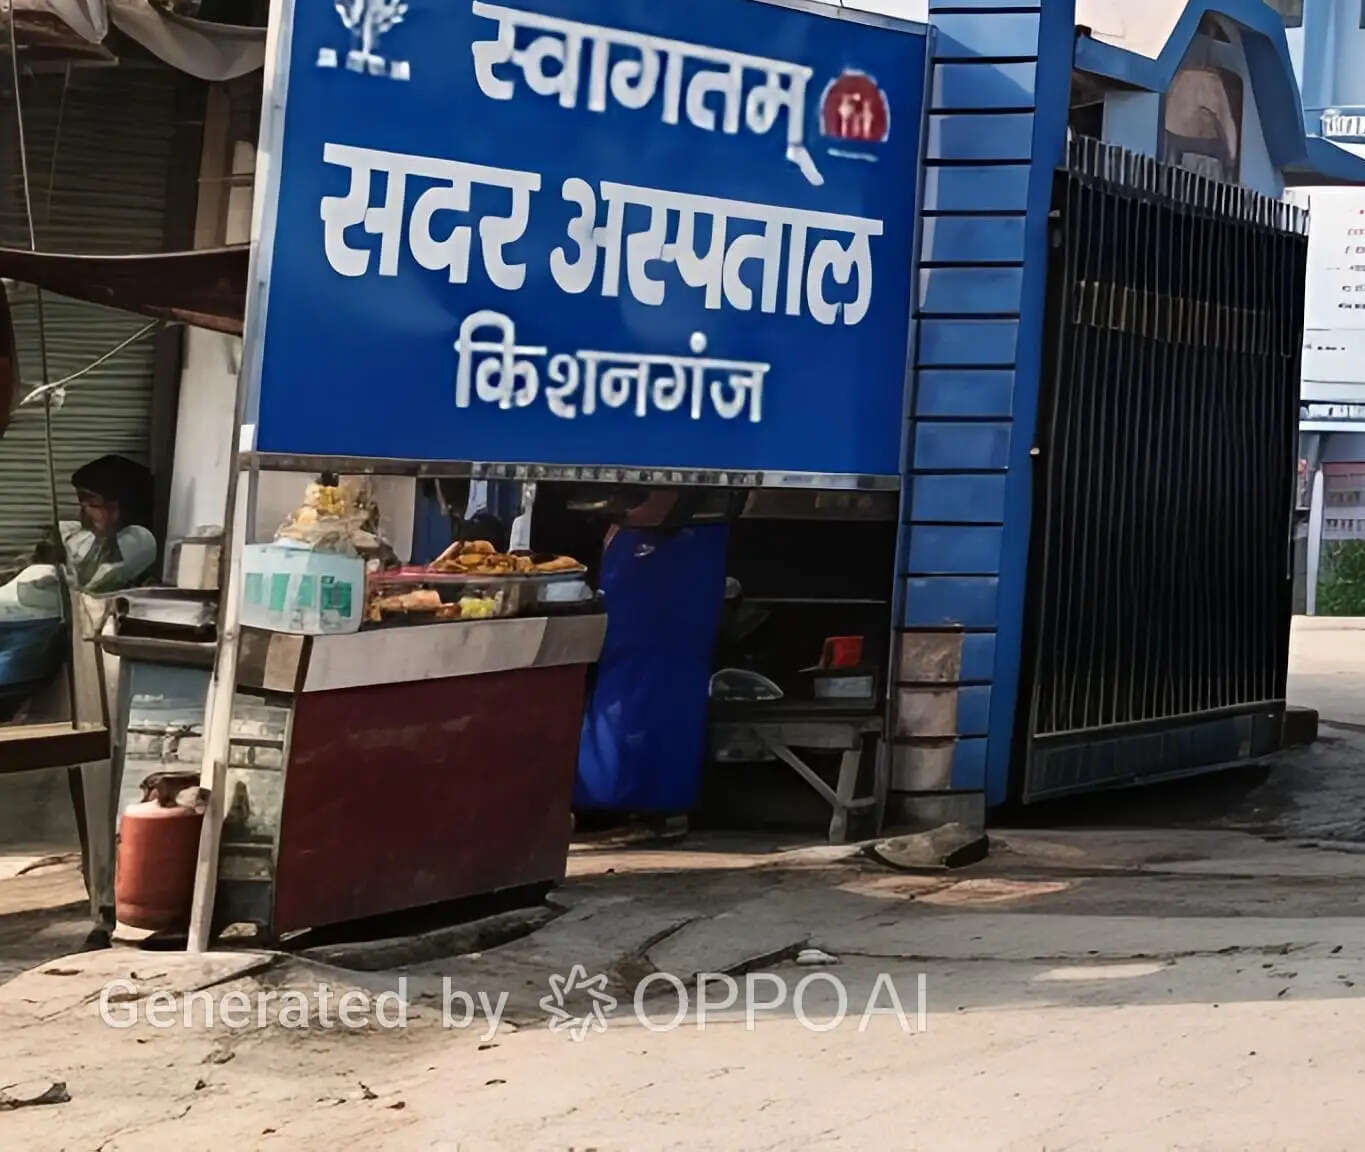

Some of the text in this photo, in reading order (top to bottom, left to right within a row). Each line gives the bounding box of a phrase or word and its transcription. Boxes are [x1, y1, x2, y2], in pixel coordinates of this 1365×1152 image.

[471, 0, 824, 186] स्वागतम्
[320, 142, 884, 326] सदर अस्पताल
[453, 310, 770, 423] किशनगंज
